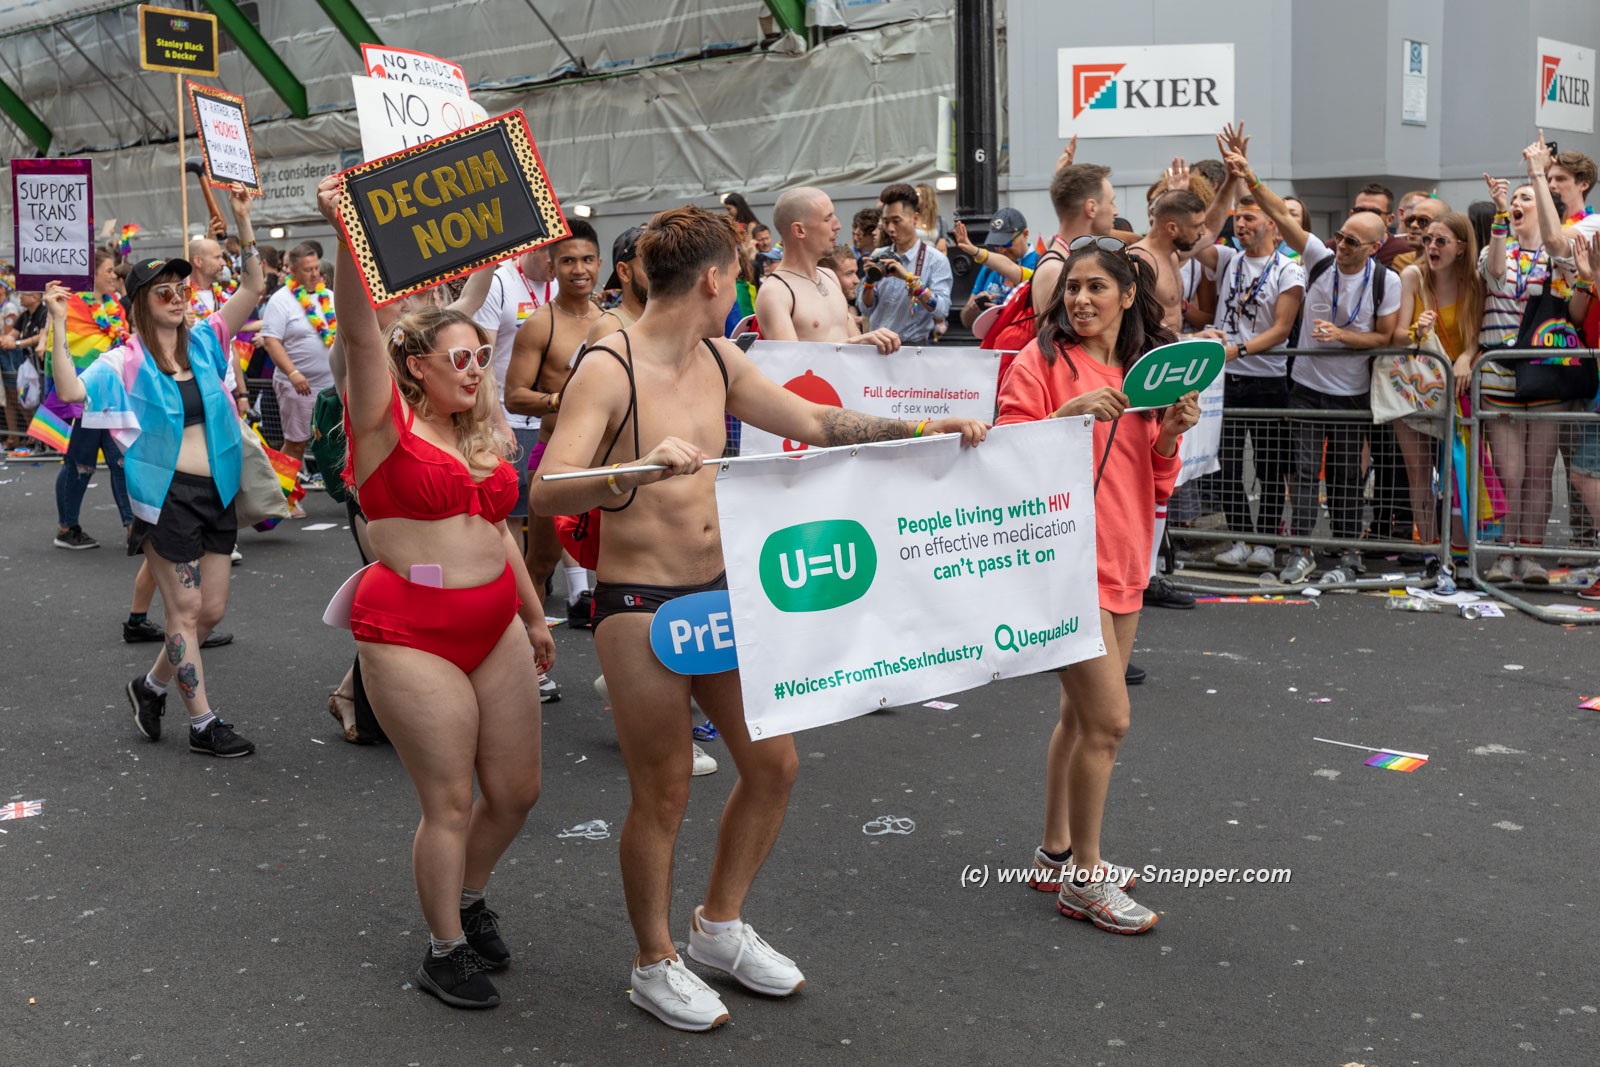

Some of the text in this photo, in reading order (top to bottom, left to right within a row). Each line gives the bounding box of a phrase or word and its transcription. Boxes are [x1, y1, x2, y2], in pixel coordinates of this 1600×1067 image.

[156, 38, 204, 52] Stanley Black
[164, 50, 197, 61] & Decker
[382, 53, 452, 80] NO RAIDS
[1123, 78, 1220, 109] KIER
[1559, 74, 1590, 107] KIER
[232, 109, 241, 121] BE
[382, 92, 429, 127] NO
[213, 118, 241, 142] HOOKER
[207, 139, 250, 163] THAN WORK FOR
[975, 148, 985, 162] 6
[213, 158, 225, 173] THE
[225, 160, 240, 176] HOME
[277, 162, 337, 182] considerate
[19, 182, 87, 203] SUPPORT
[258, 184, 305, 200] structors
[367, 150, 509, 225] DECRIM
[27, 203, 77, 221] TRANS
[34, 224, 68, 242] SEX
[411, 197, 503, 260] NOW
[22, 247, 88, 266] WORKERS
[1143, 358, 1209, 391] U=U
[863, 386, 980, 400] Full decriminalisation
[891, 402, 949, 414] of sex work
[898, 491, 1071, 536] People living with HIV
[900, 519, 1076, 561] on effective medication
[779, 542, 858, 589] U=U
[933, 547, 1056, 580] can't pass it on
[669, 611, 734, 655] PrE
[774, 642, 984, 700] #VoicesFromTheSexIndustry
